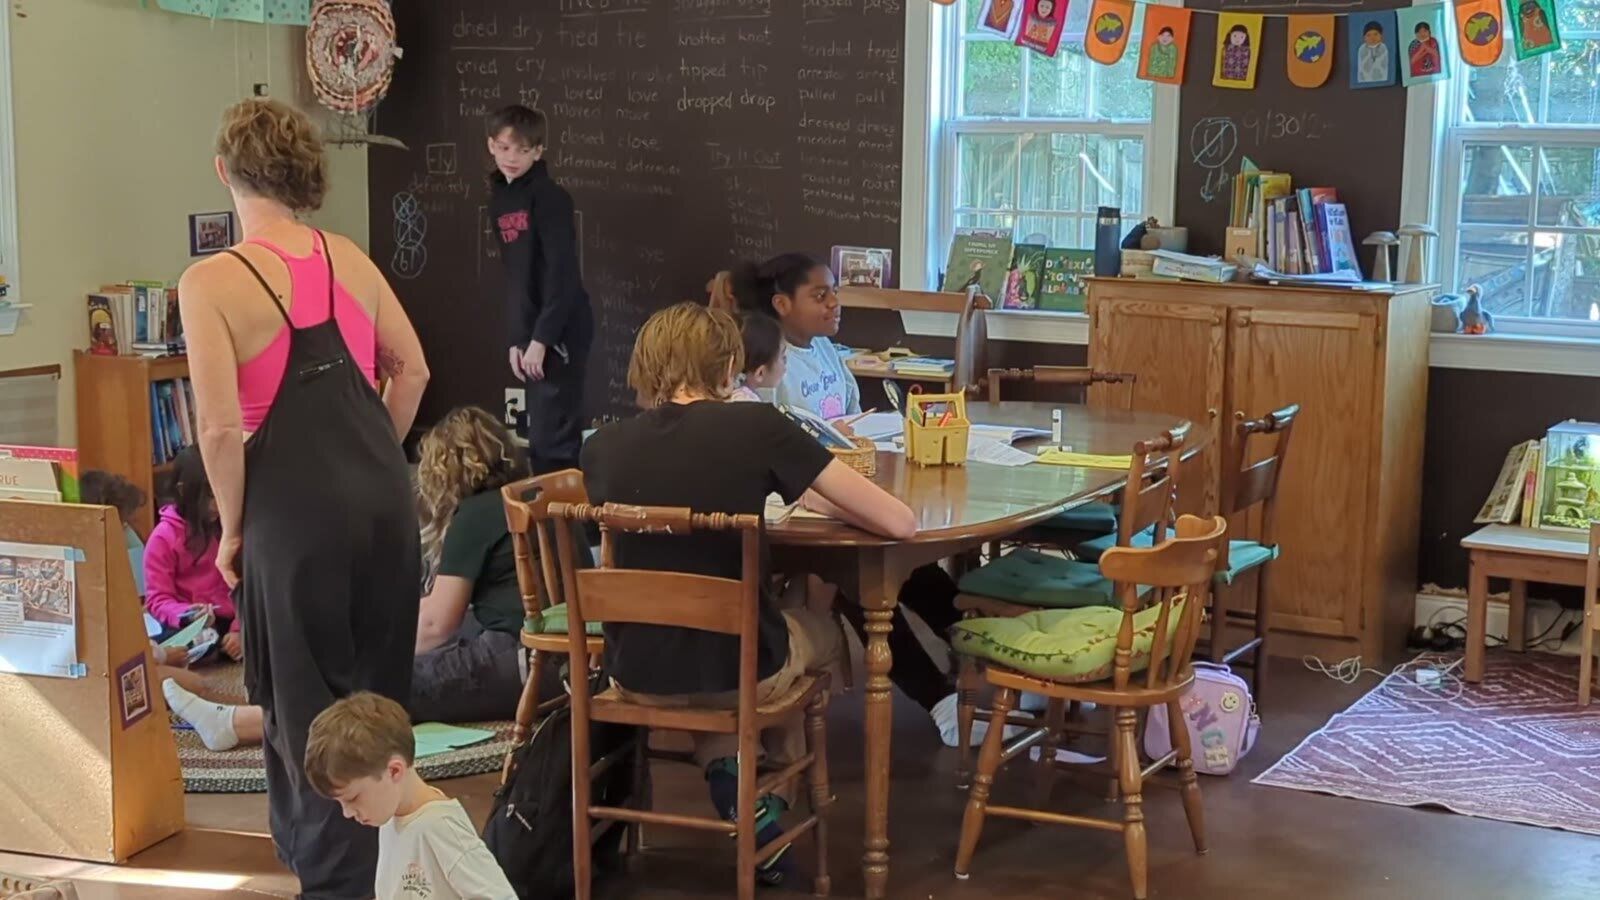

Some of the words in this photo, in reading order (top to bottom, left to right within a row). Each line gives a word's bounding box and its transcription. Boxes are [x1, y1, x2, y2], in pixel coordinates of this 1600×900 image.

[451, 9, 498, 38] dried
[512, 15, 544, 46] dry
[456, 58, 498, 75] cried
[515, 57, 547, 81] cry
[679, 57, 727, 80] tipped
[739, 56, 768, 80] tip
[459, 80, 501, 99] tried
[565, 85, 603, 100] loved
[628, 86, 659, 103] love
[676, 86, 733, 115] dropped
[740, 88, 777, 113] drop
